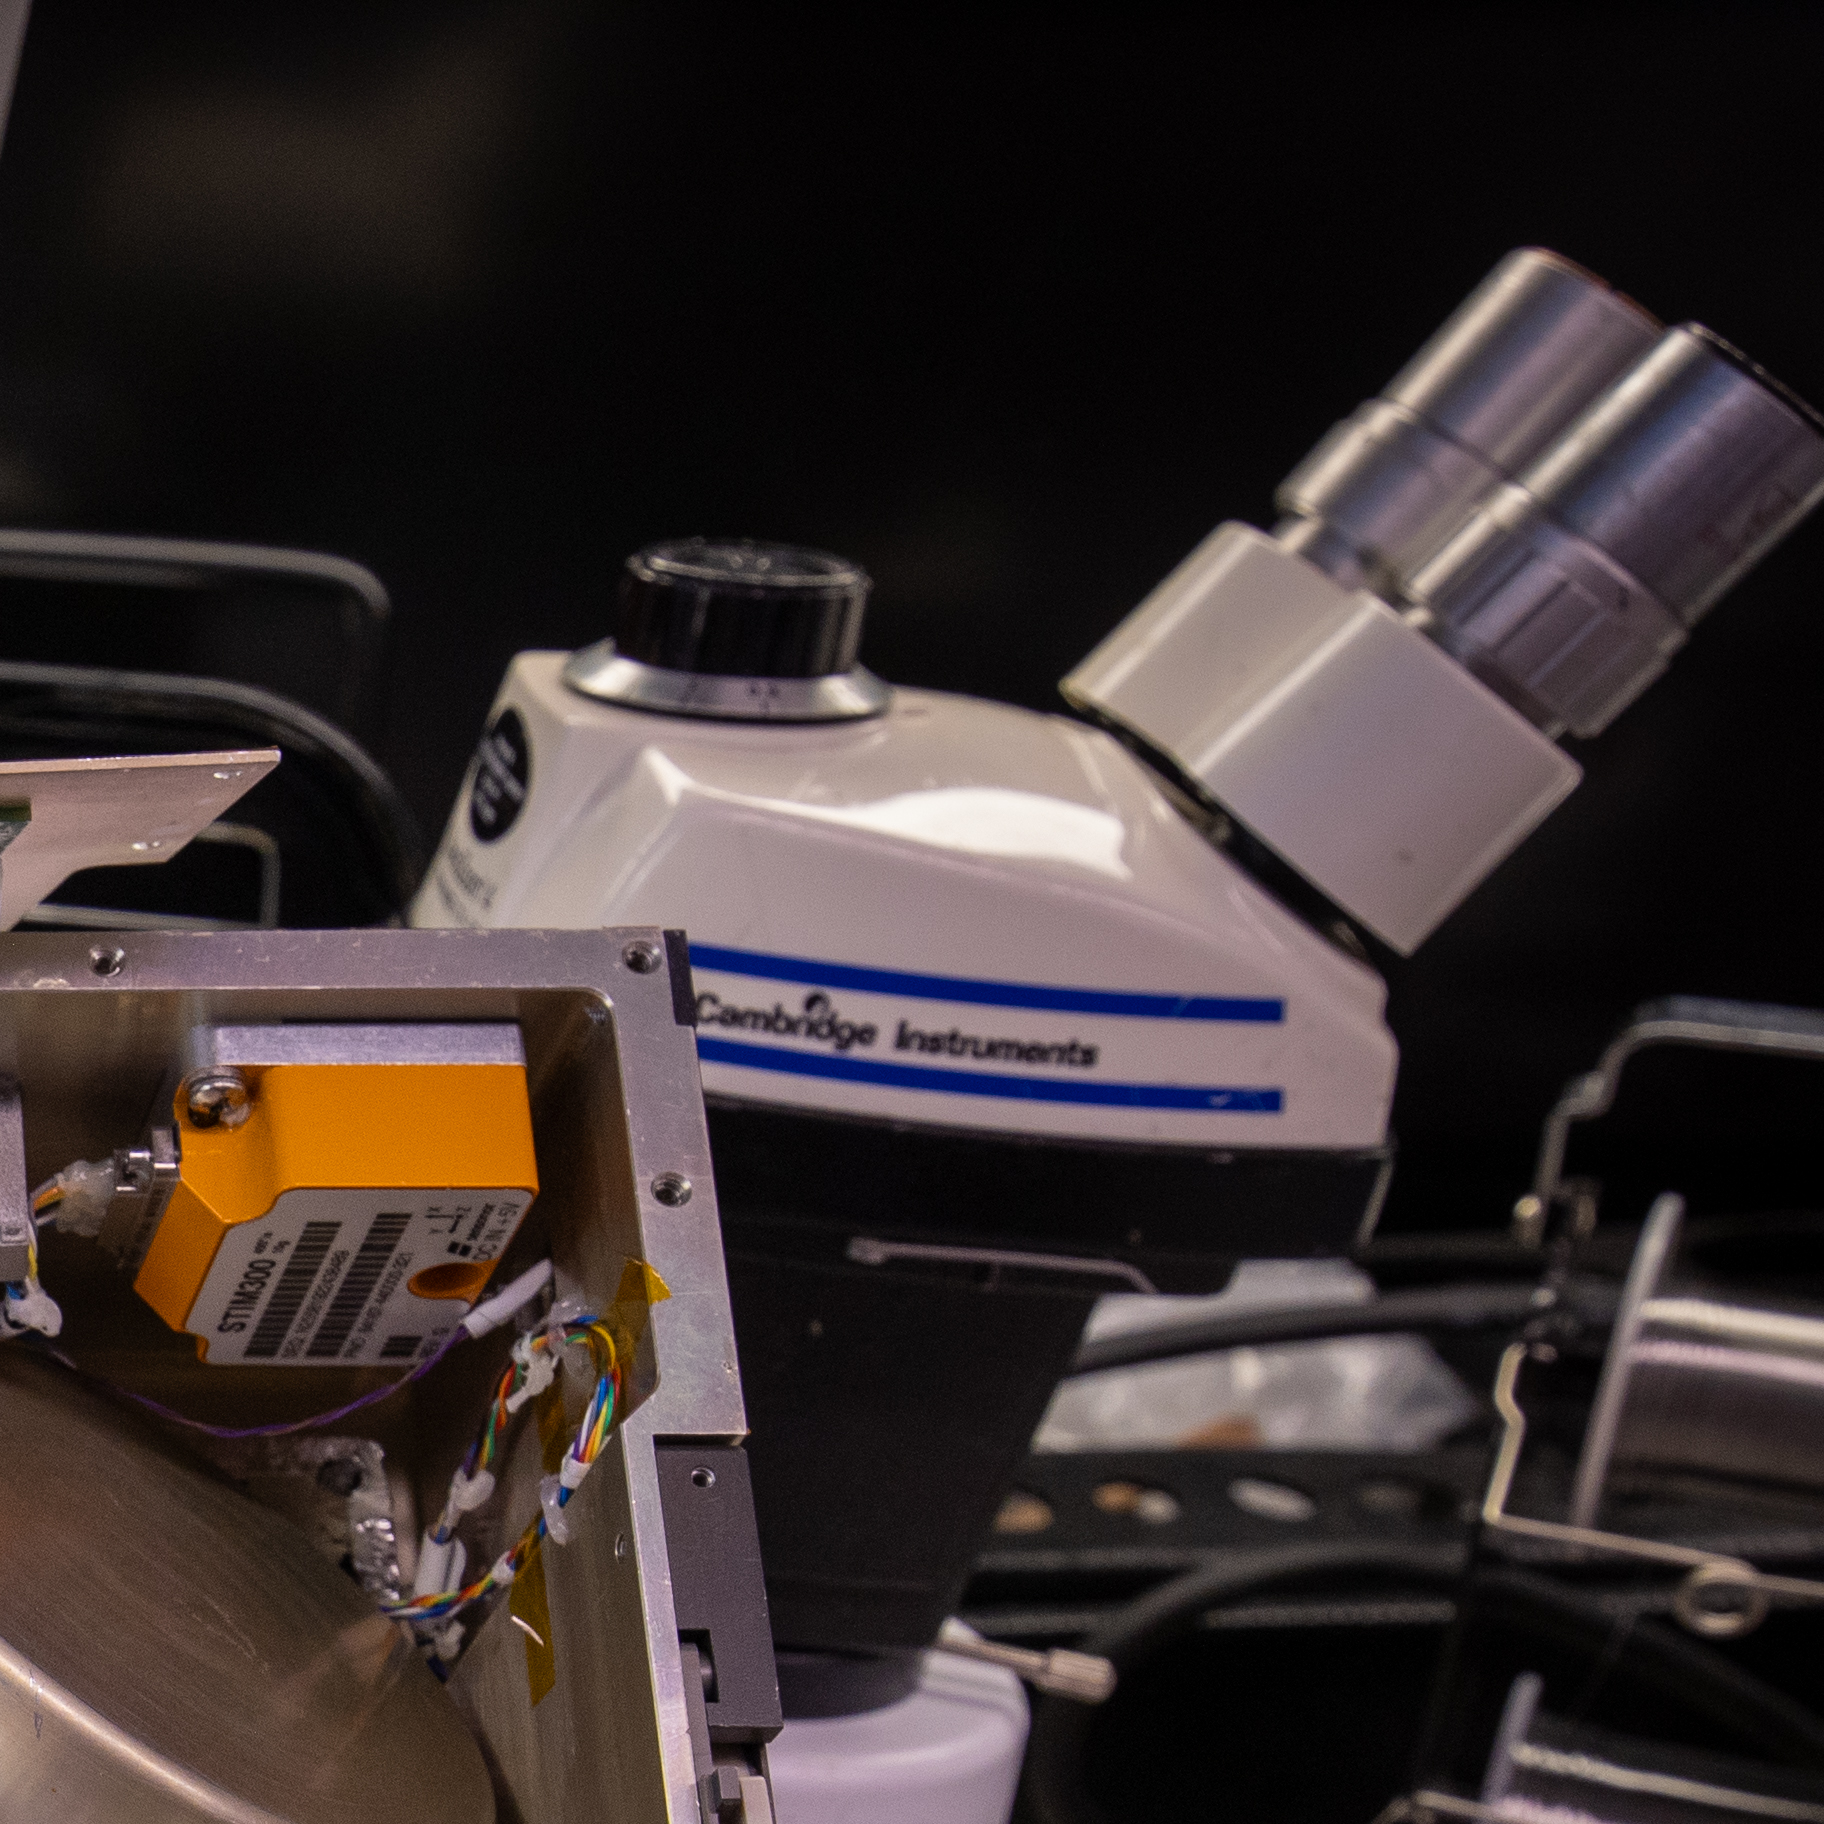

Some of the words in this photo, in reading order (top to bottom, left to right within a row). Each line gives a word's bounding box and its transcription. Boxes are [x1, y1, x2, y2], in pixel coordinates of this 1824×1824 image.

[695, 990, 878, 1053] Cambridge
[893, 1016, 1100, 1071] Instruments
[217, 1258, 277, 1335] STIM300
